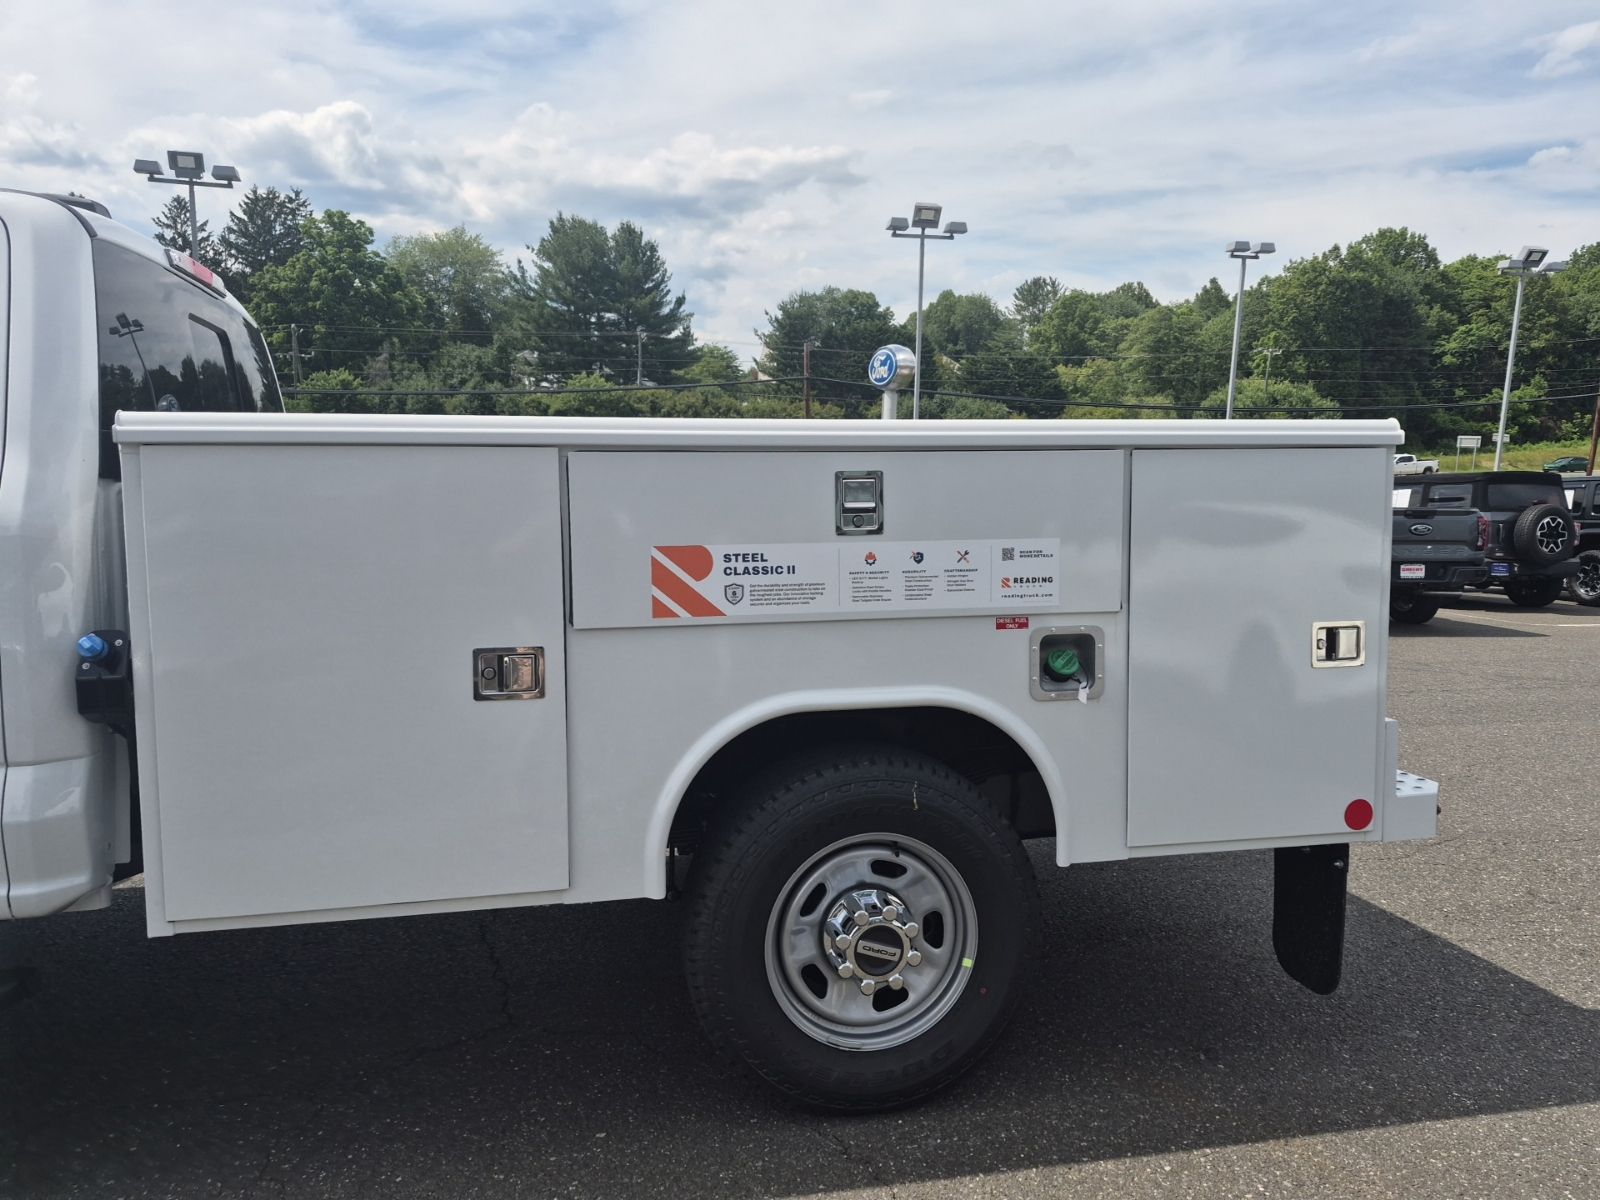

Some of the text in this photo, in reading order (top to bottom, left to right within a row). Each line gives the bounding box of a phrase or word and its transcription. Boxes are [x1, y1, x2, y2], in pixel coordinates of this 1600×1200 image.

[723, 553, 768, 563] STEEL
[723, 565, 796, 576] CLASSIC II
[1013, 576, 1054, 584] READING
[862, 945, 897, 957] FORD
